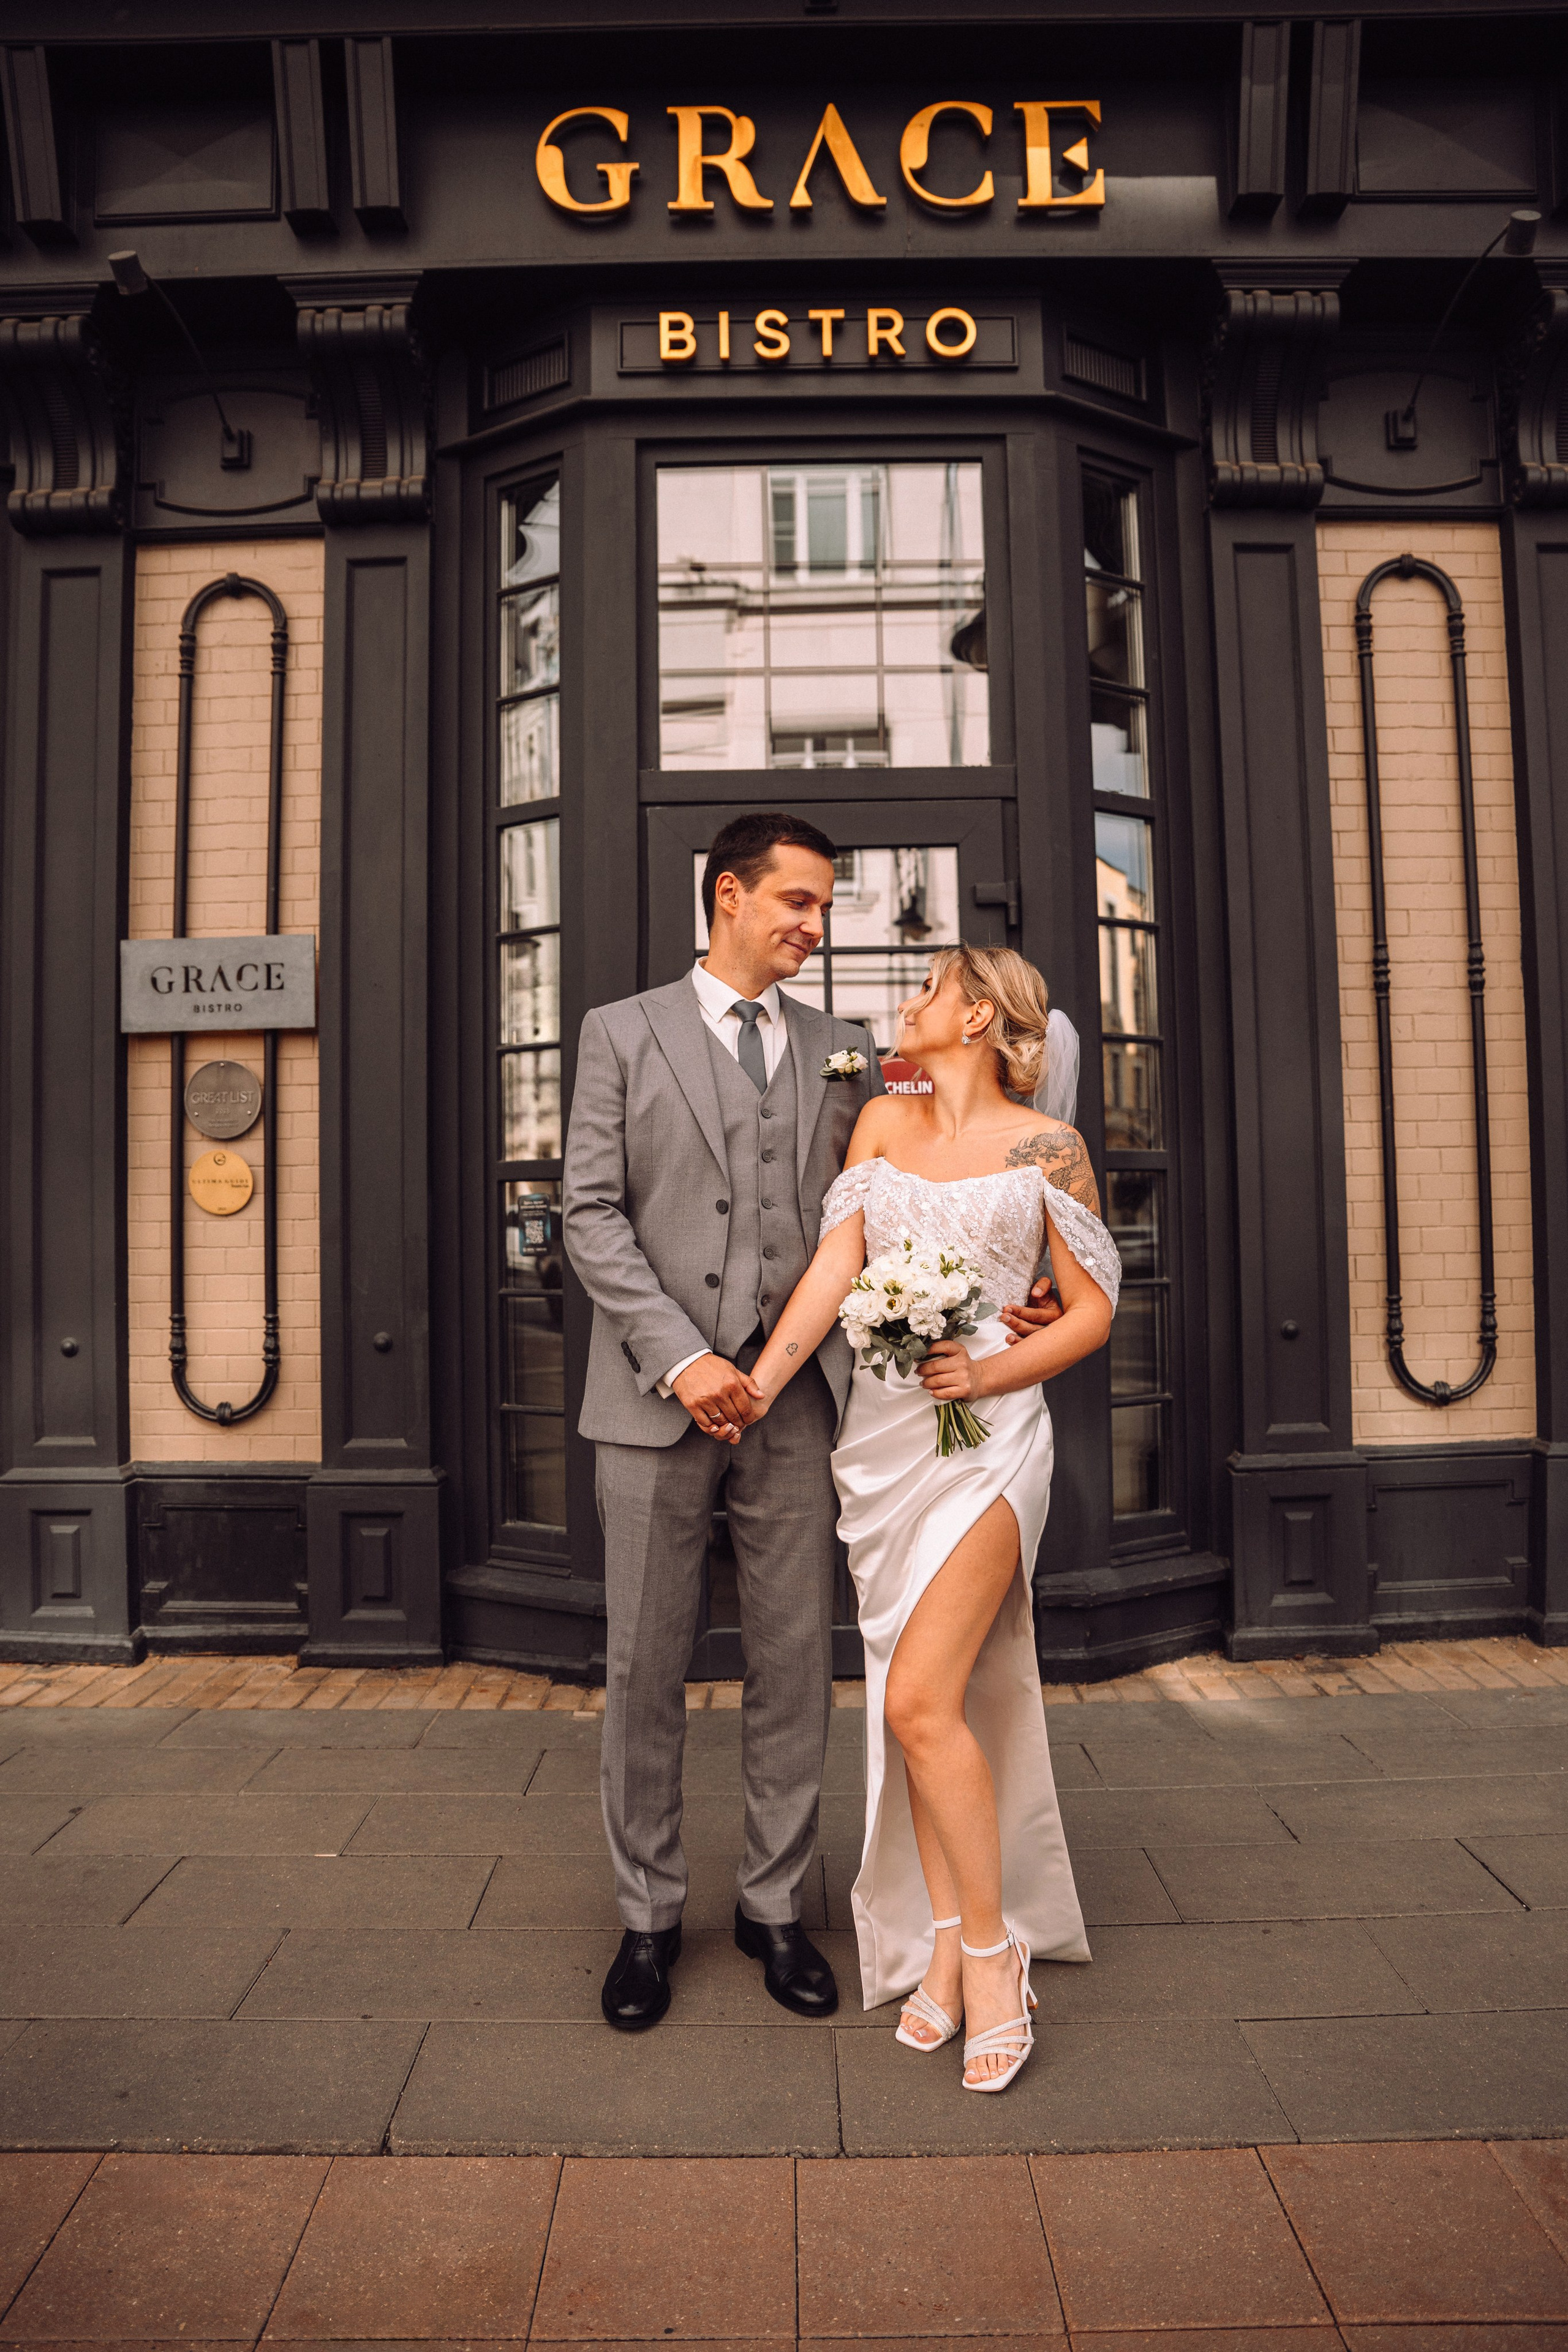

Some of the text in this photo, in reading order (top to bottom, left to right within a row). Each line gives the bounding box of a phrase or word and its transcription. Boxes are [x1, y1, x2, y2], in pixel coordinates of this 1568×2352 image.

[535, 100, 1105, 215] GRACE
[658, 307, 978, 361] BISTRO
[150, 962, 284, 995] GRACE
[193, 1003, 243, 1014] BISTRO
